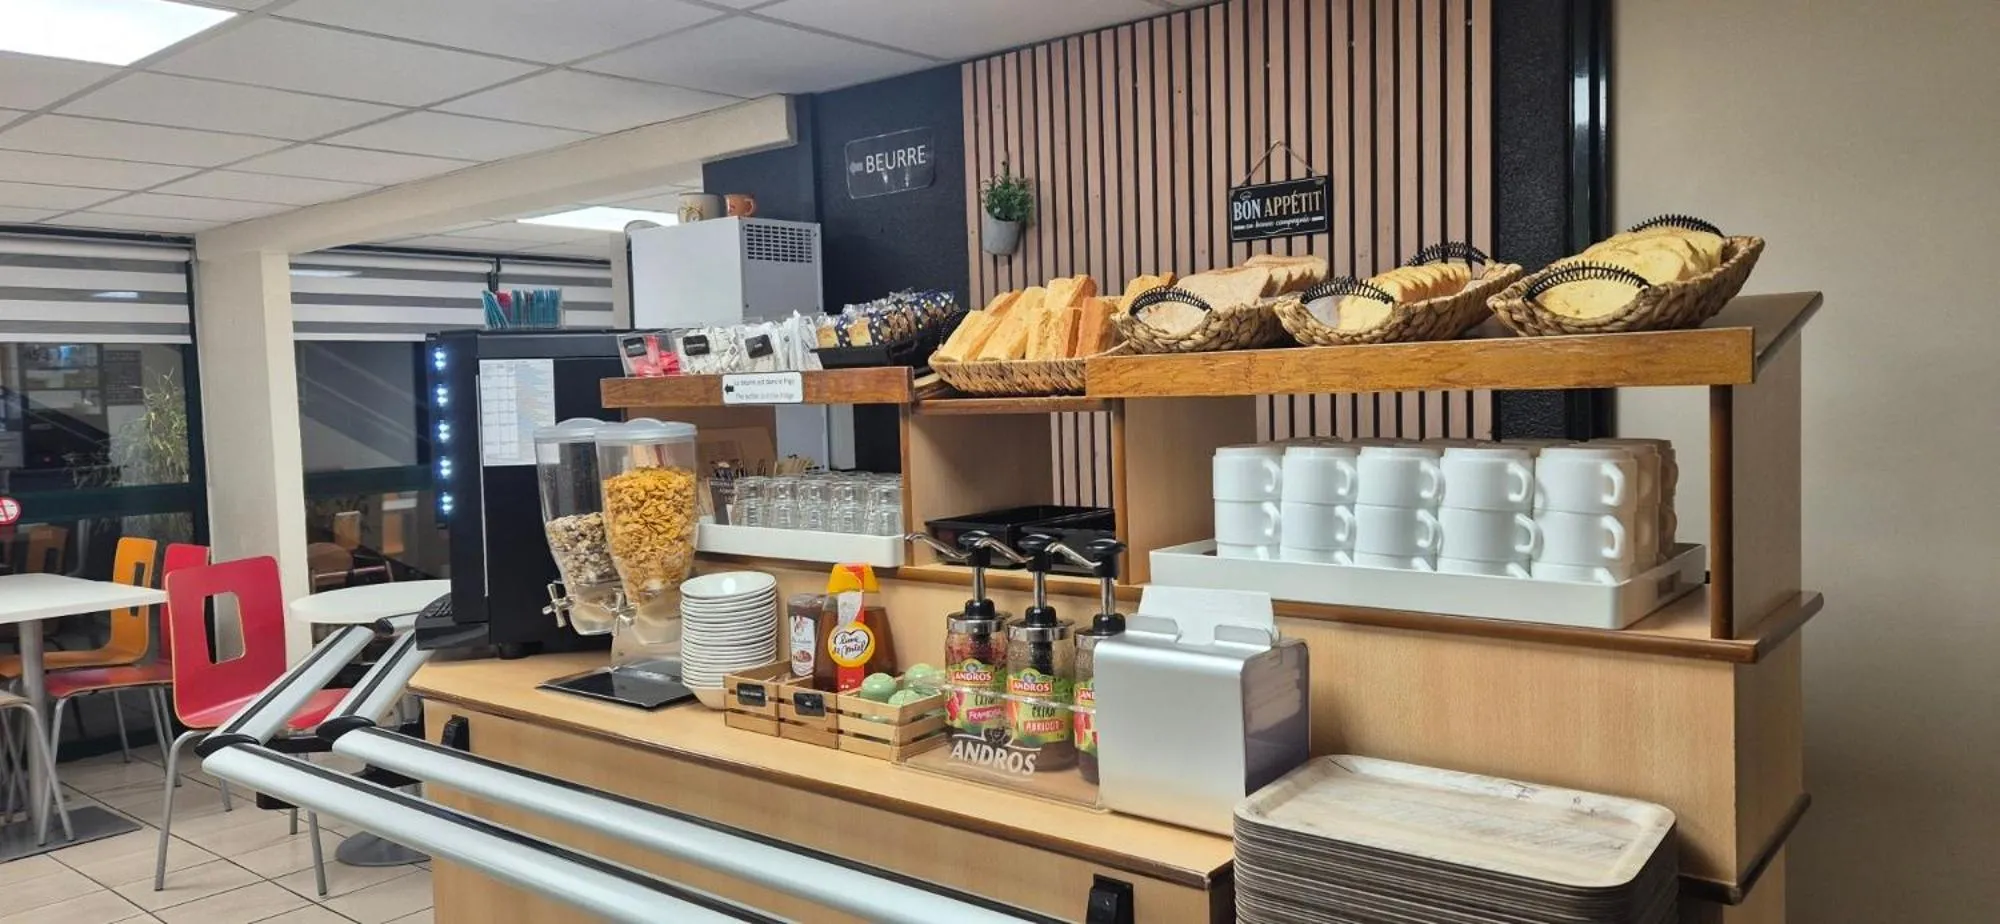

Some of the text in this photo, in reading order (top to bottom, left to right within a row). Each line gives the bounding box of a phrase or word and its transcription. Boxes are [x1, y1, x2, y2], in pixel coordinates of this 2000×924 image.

[866, 145, 927, 174] BEURRE
[1233, 190, 1323, 221] BON APPÉTIT
[955, 672, 992, 681] ANDROS
[1013, 681, 1050, 692] ANDROS
[950, 739, 1037, 776] ANDROS
